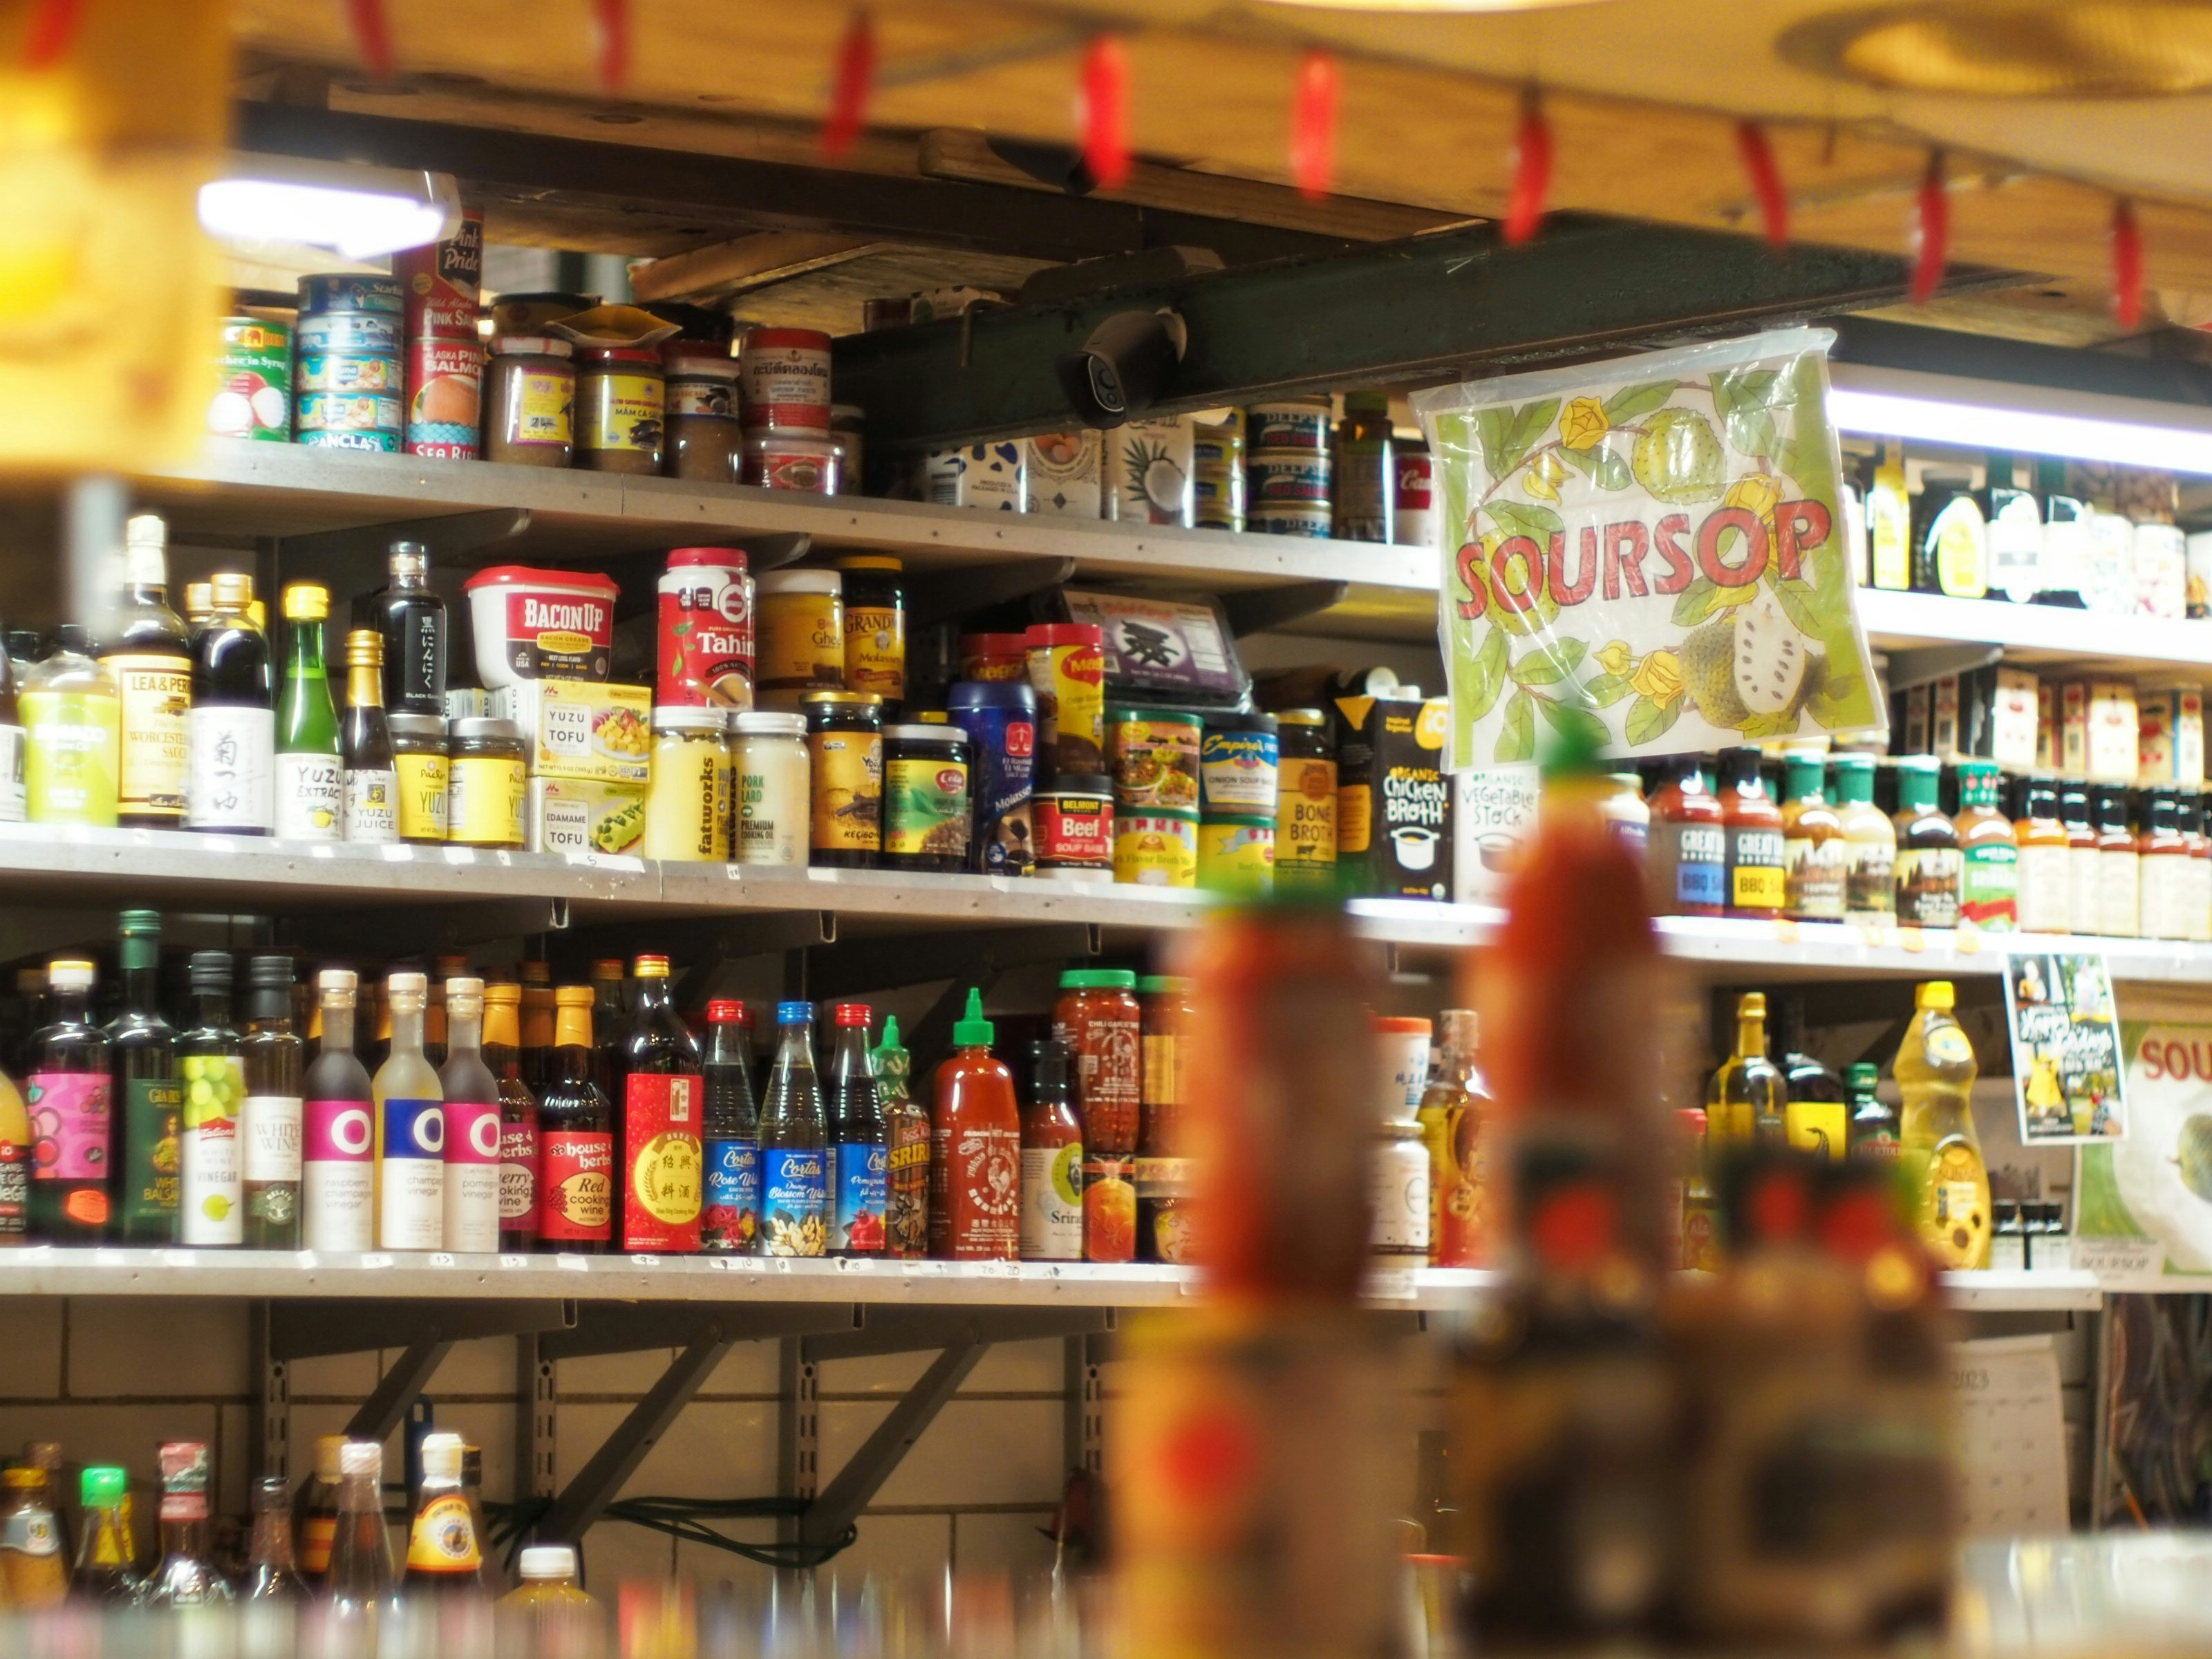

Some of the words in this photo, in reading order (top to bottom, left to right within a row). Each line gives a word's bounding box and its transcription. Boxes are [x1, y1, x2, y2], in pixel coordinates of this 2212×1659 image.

[1454, 498, 1833, 621] SOURSOP
[420, 616, 435, 689] 黒にんにく
[131, 675, 156, 691] LEA
[158, 676, 167, 690] &
[549, 711, 585, 723] YUZU
[548, 729, 585, 743] TOFU
[741, 774, 765, 788] PORK
[1208, 776, 1237, 785] ONION
[1238, 776, 1260, 785] SOUP
[1389, 766, 1441, 782] ORGANIC
[297, 785, 341, 799] EXTRAC
[741, 789, 762, 803] LARD
[509, 795, 525, 819] YUZ
[697, 756, 713, 855] fatworks
[1062, 800, 1100, 811] BELMONT
[357, 808, 393, 818] YUZU
[546, 812, 585, 824] EDAMAME
[1295, 803, 1331, 823] BONE
[355, 820, 394, 830] JUICE
[740, 820, 774, 831] PREMIUM
[1062, 817, 1101, 838] Beef
[550, 832, 583, 845] TOFU
[740, 831, 765, 840] COOKING
[1290, 823, 1334, 845] BROTH
[1055, 843, 1082, 853] SOUP
[1126, 854, 1154, 865] Flavor
[1156, 855, 1179, 865] Broth
[1682, 872, 1709, 892] BBQ
[1739, 877, 1765, 894] BBQ
[255, 1123, 301, 1138] WHITE
[261, 1138, 298, 1152] WINE
[565, 1142, 606, 1157] house
[578, 1154, 612, 1170] herbs
[722, 1150, 756, 1168] Cortas
[889, 1141, 930, 1170] SRIR
[780, 1158, 822, 1178] Cortas
[196, 1171, 237, 1183] VINEGAR
[325, 1179, 368, 1189] raspberry
[499, 1173, 530, 1188] erry
[708, 1171, 738, 1188] Rose
[407, 1186, 439, 1197] vinegar
[499, 1185, 530, 1197] oking
[578, 1177, 605, 1193] Red
[462, 1190, 494, 1201] vinegar
[768, 1186, 805, 1200] Blossom
[326, 1200, 362, 1209] vinegar
[569, 1194, 610, 1208] cooking
[579, 1205, 603, 1215] wine
[673, 1208, 688, 1216] Cooking
